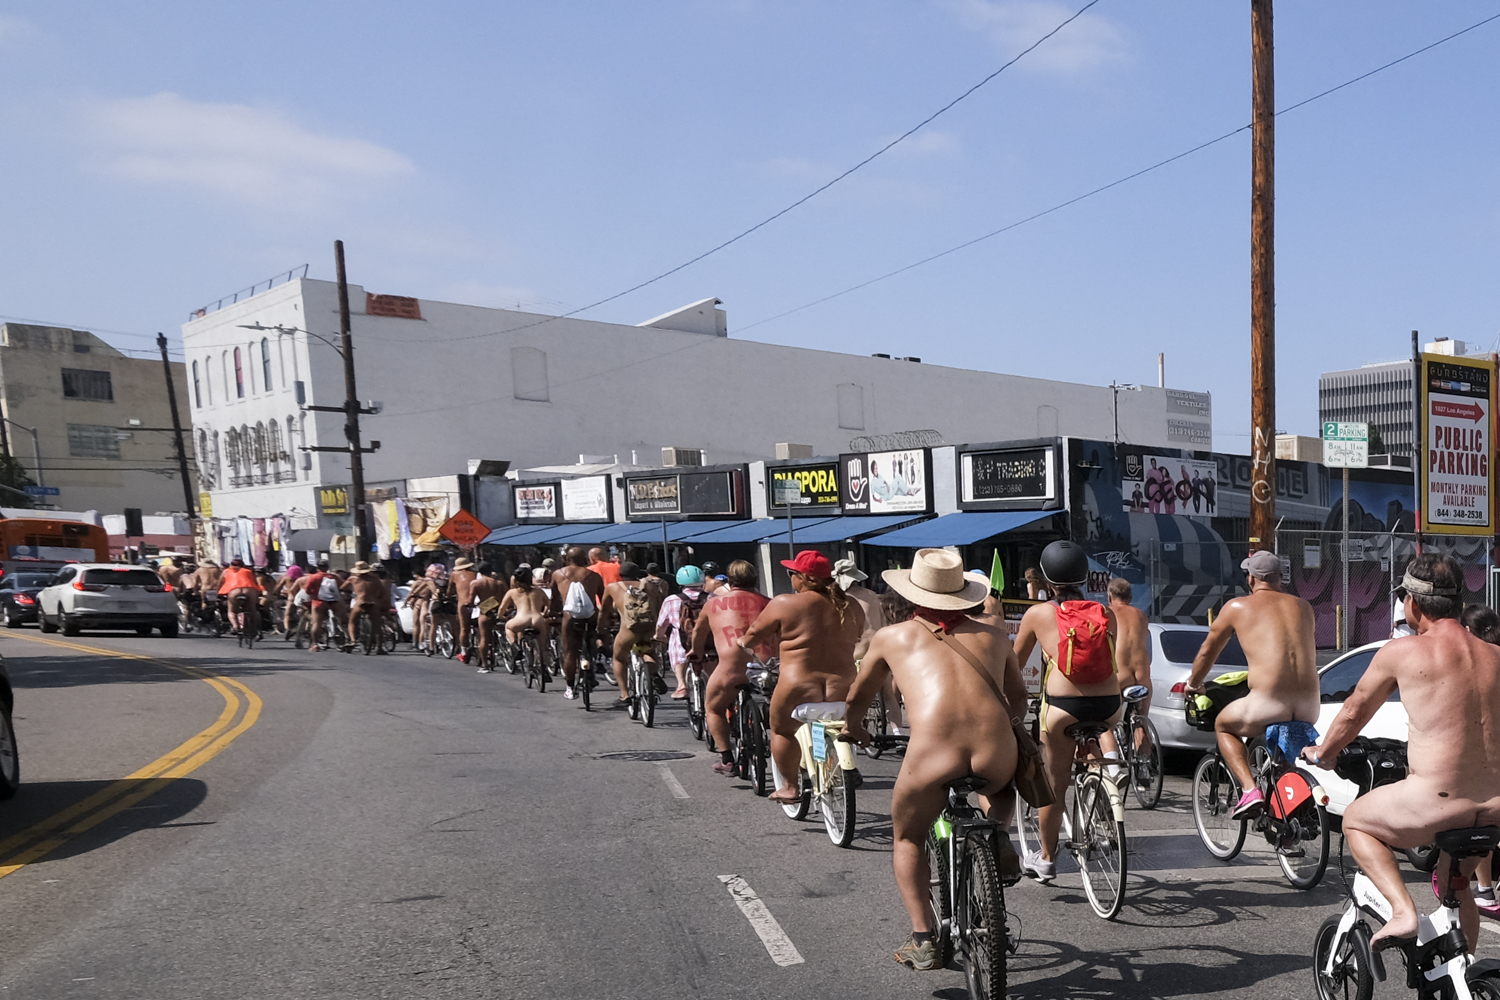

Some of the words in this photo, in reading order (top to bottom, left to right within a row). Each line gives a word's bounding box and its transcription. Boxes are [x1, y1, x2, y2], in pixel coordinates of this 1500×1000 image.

[1327, 424, 1335, 436] 2
[1340, 429, 1366, 437] PARKING
[1435, 425, 1483, 452] PUBLIC
[1430, 449, 1487, 477] PARKING
[1430, 482, 1459, 494] MONTHLY
[1461, 484, 1487, 496] PARKING
[1443, 495, 1475, 507] AVAILABLE
[1435, 508, 1451, 518] (844)
[1453, 509, 1483, 519] 348-2538
